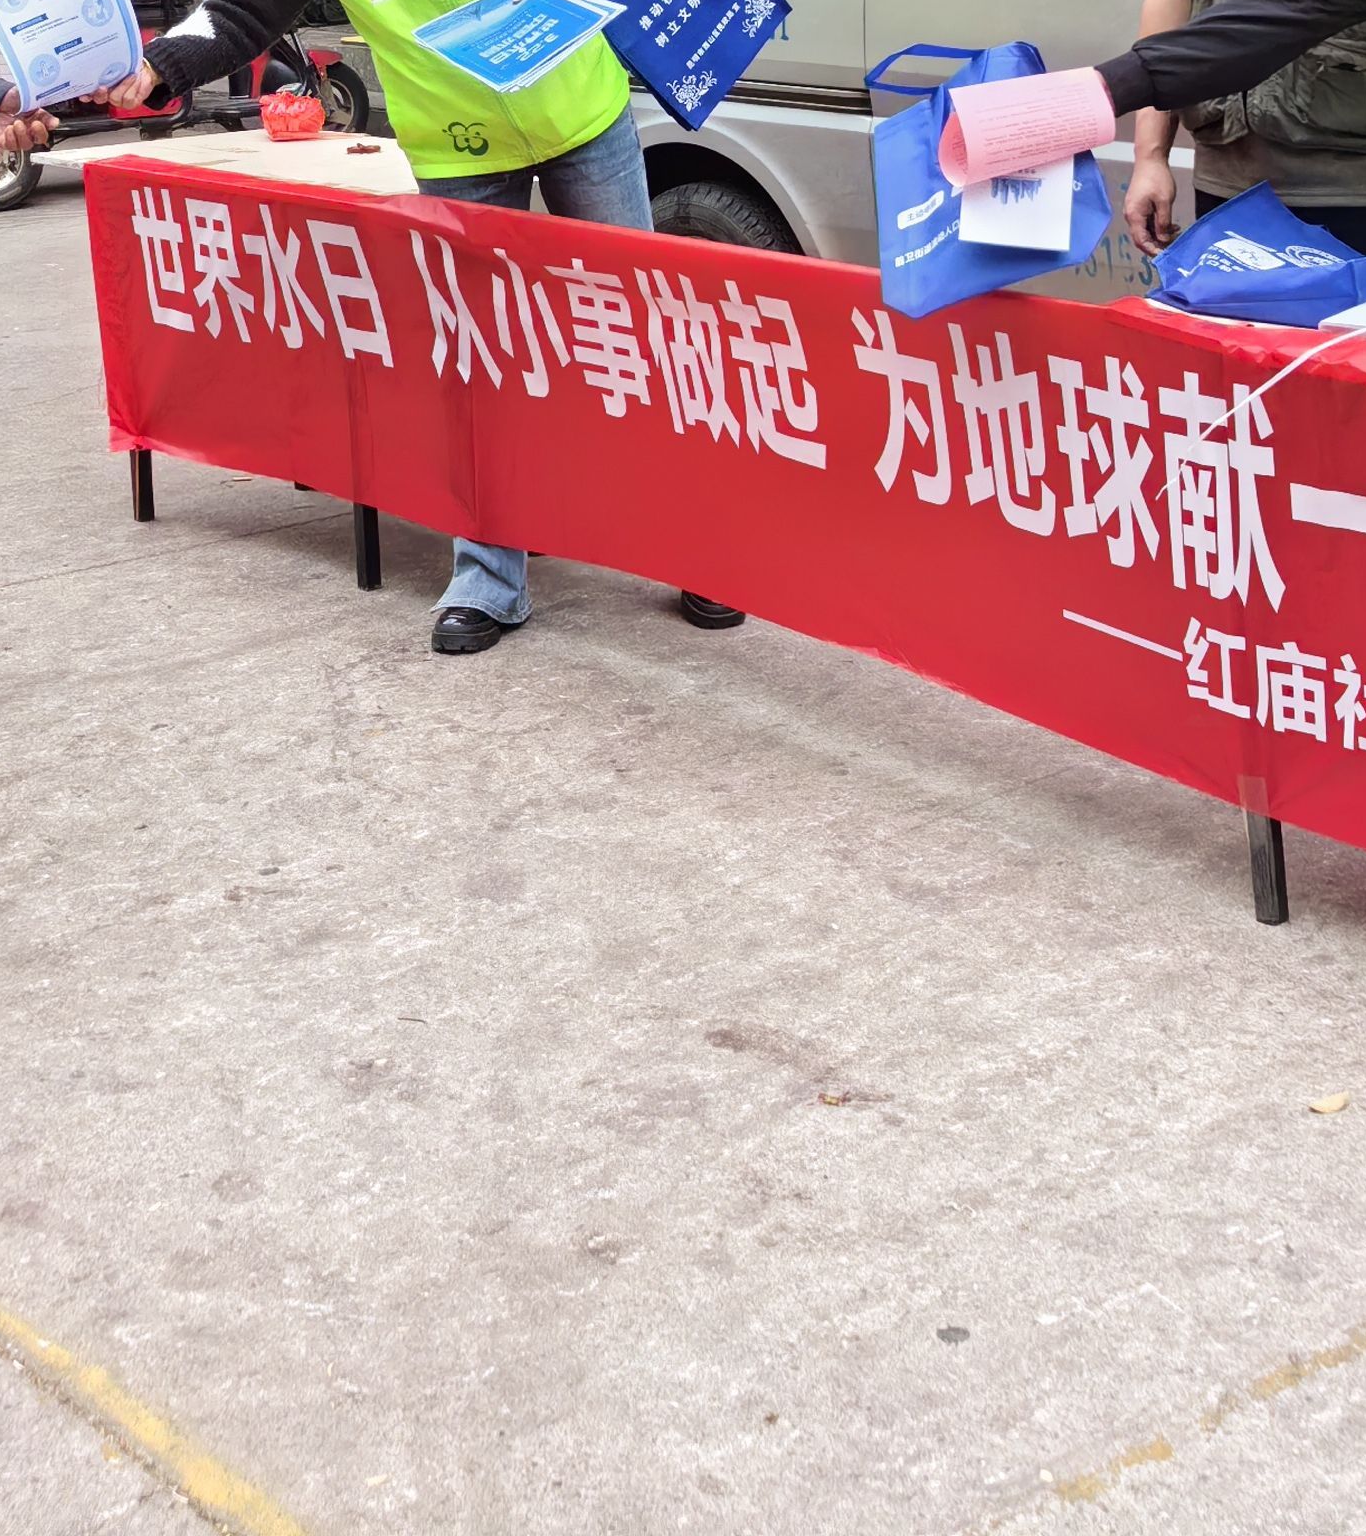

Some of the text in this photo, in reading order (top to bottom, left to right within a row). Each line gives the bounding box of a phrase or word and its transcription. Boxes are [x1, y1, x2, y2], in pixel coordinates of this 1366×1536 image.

[132, 185, 394, 369] 世界水日
[407, 228, 827, 471] 从小事做起
